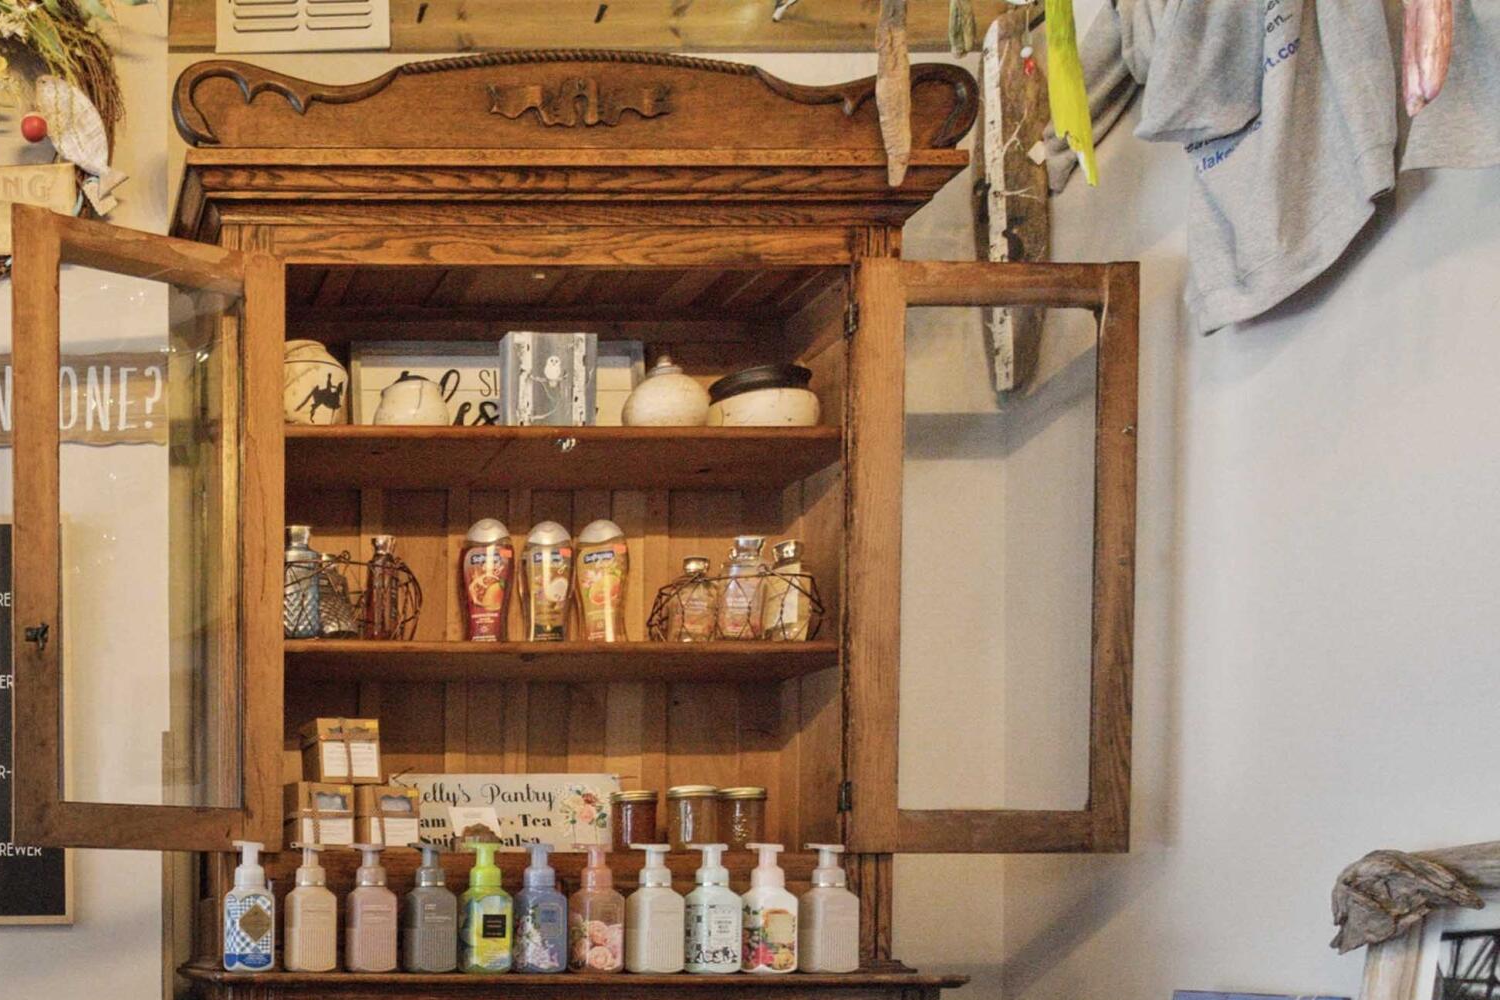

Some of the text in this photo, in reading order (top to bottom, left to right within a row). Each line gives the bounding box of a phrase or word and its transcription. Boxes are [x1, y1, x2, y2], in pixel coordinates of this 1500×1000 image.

[422, 782, 555, 811] elly's Pantry
[419, 816, 446, 828] am
[518, 813, 552, 827] Tea
